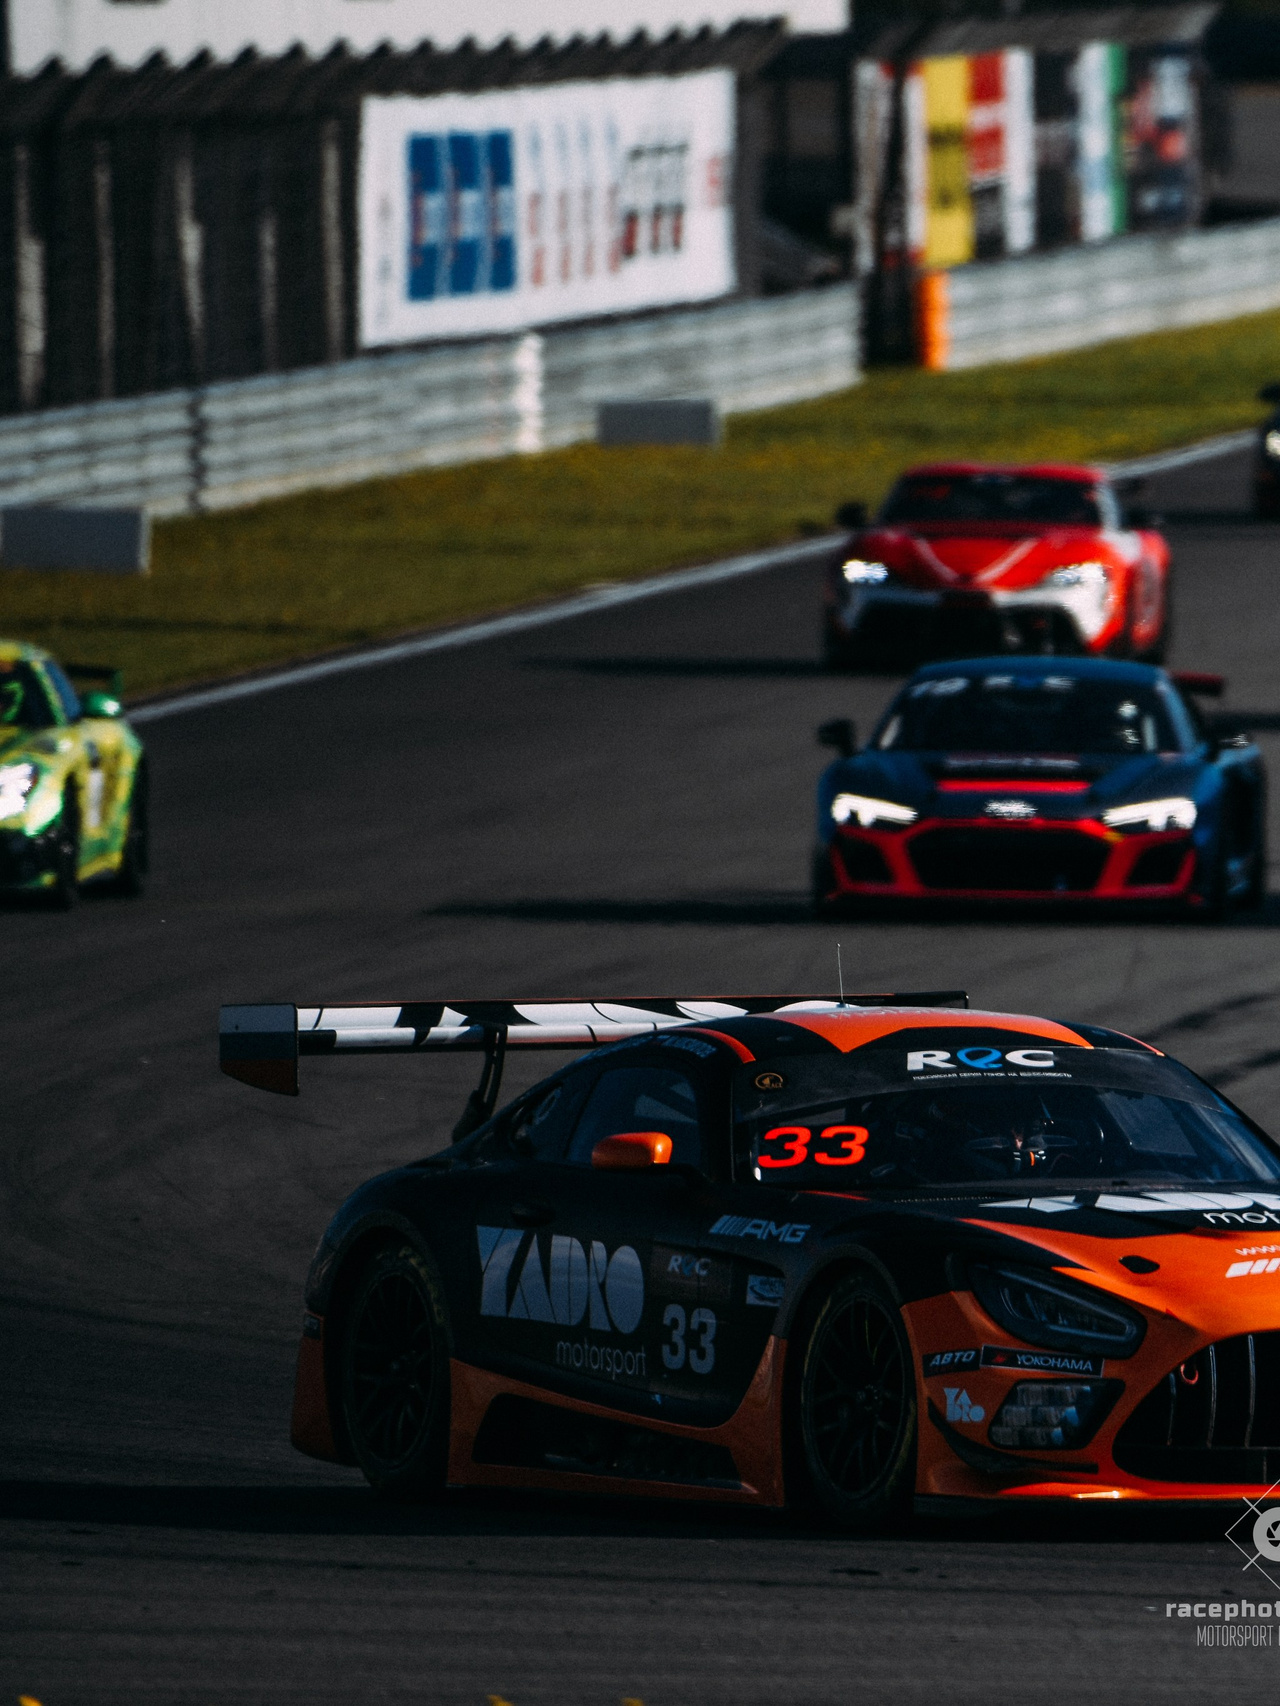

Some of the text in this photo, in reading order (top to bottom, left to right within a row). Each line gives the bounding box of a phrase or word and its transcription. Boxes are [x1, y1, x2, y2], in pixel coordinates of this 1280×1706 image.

[757, 1125, 869, 1168] 33
[740, 1219, 811, 1243] AMG
[556, 1338, 647, 1380] motorsport
[662, 1303, 717, 1375] 33
[1016, 1353, 1094, 1372] YOKOHAMA
